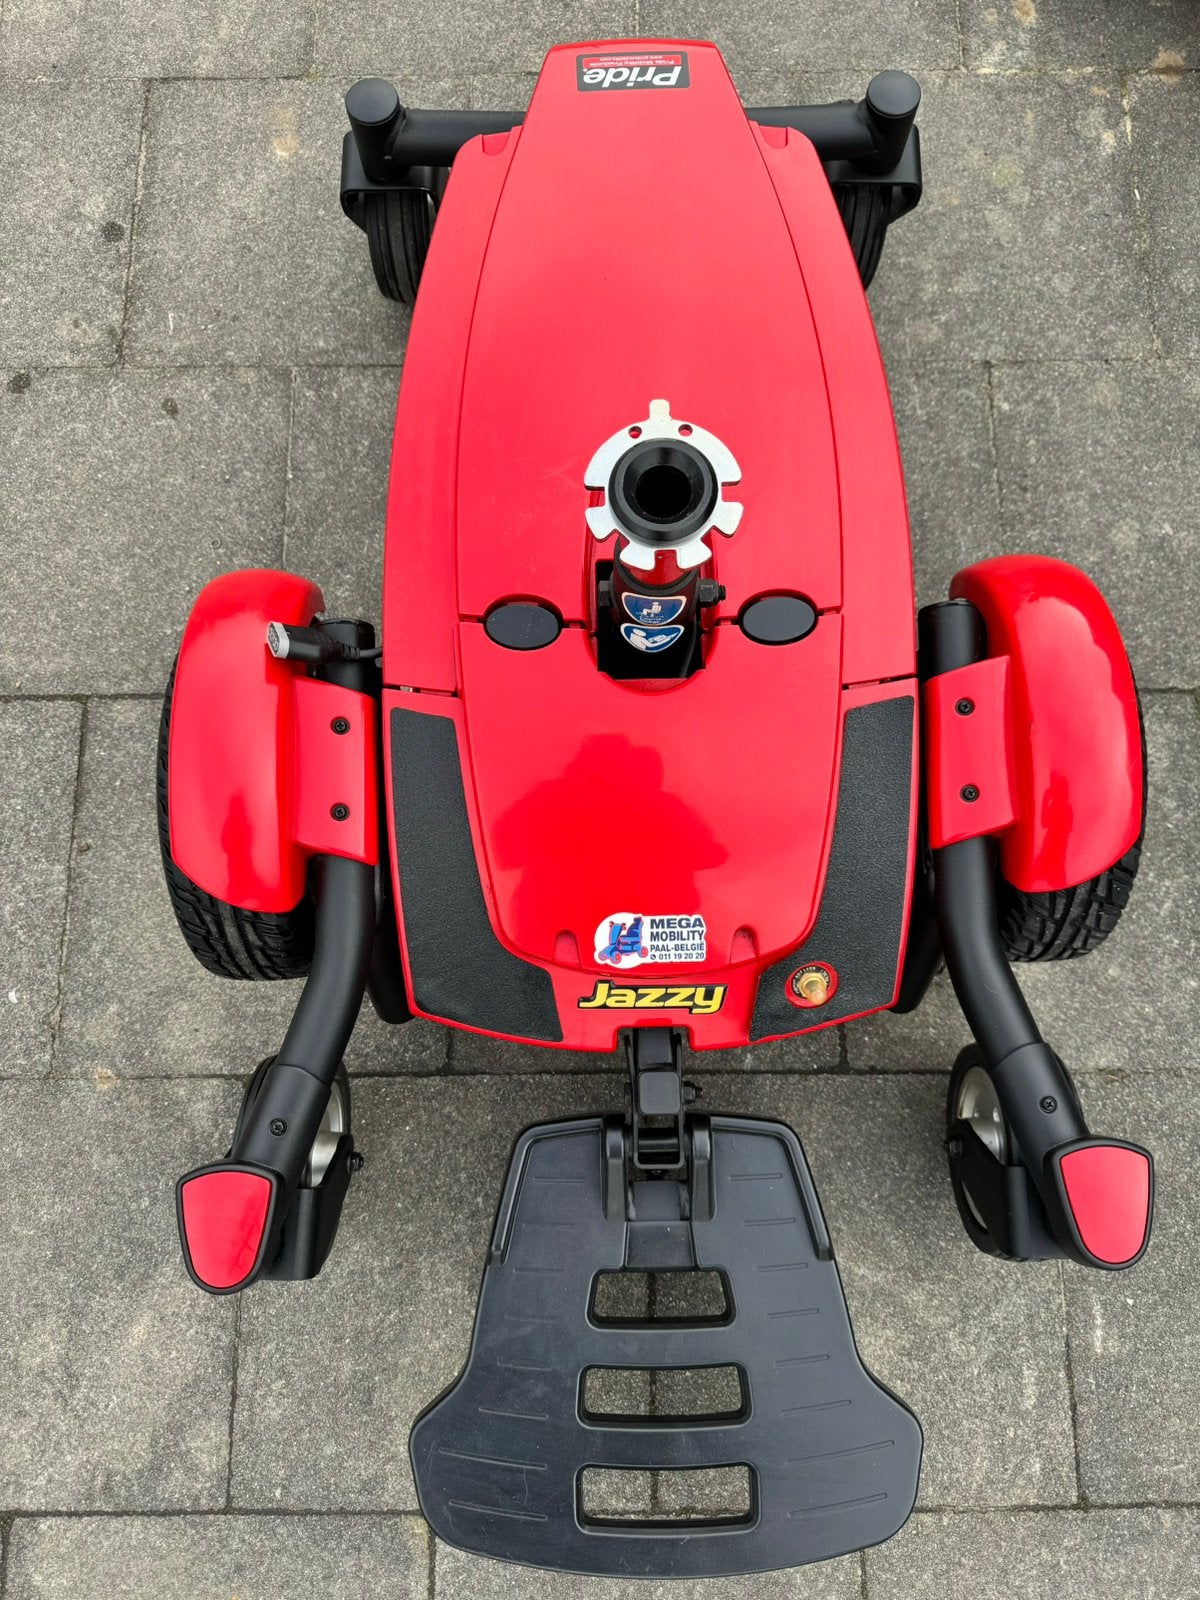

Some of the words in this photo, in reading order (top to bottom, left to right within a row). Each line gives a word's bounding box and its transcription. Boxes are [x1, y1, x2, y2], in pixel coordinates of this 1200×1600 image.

[650, 917, 704, 929] MEGA
[650, 930, 704, 942] MOBILITY
[650, 941, 705, 953] PAAL-BELGIË
[659, 952, 672, 960] 011
[674, 952, 683, 960] 19
[684, 952, 694, 960] 20
[695, 952, 705, 960] 20
[579, 982, 725, 1014] Jazzy
